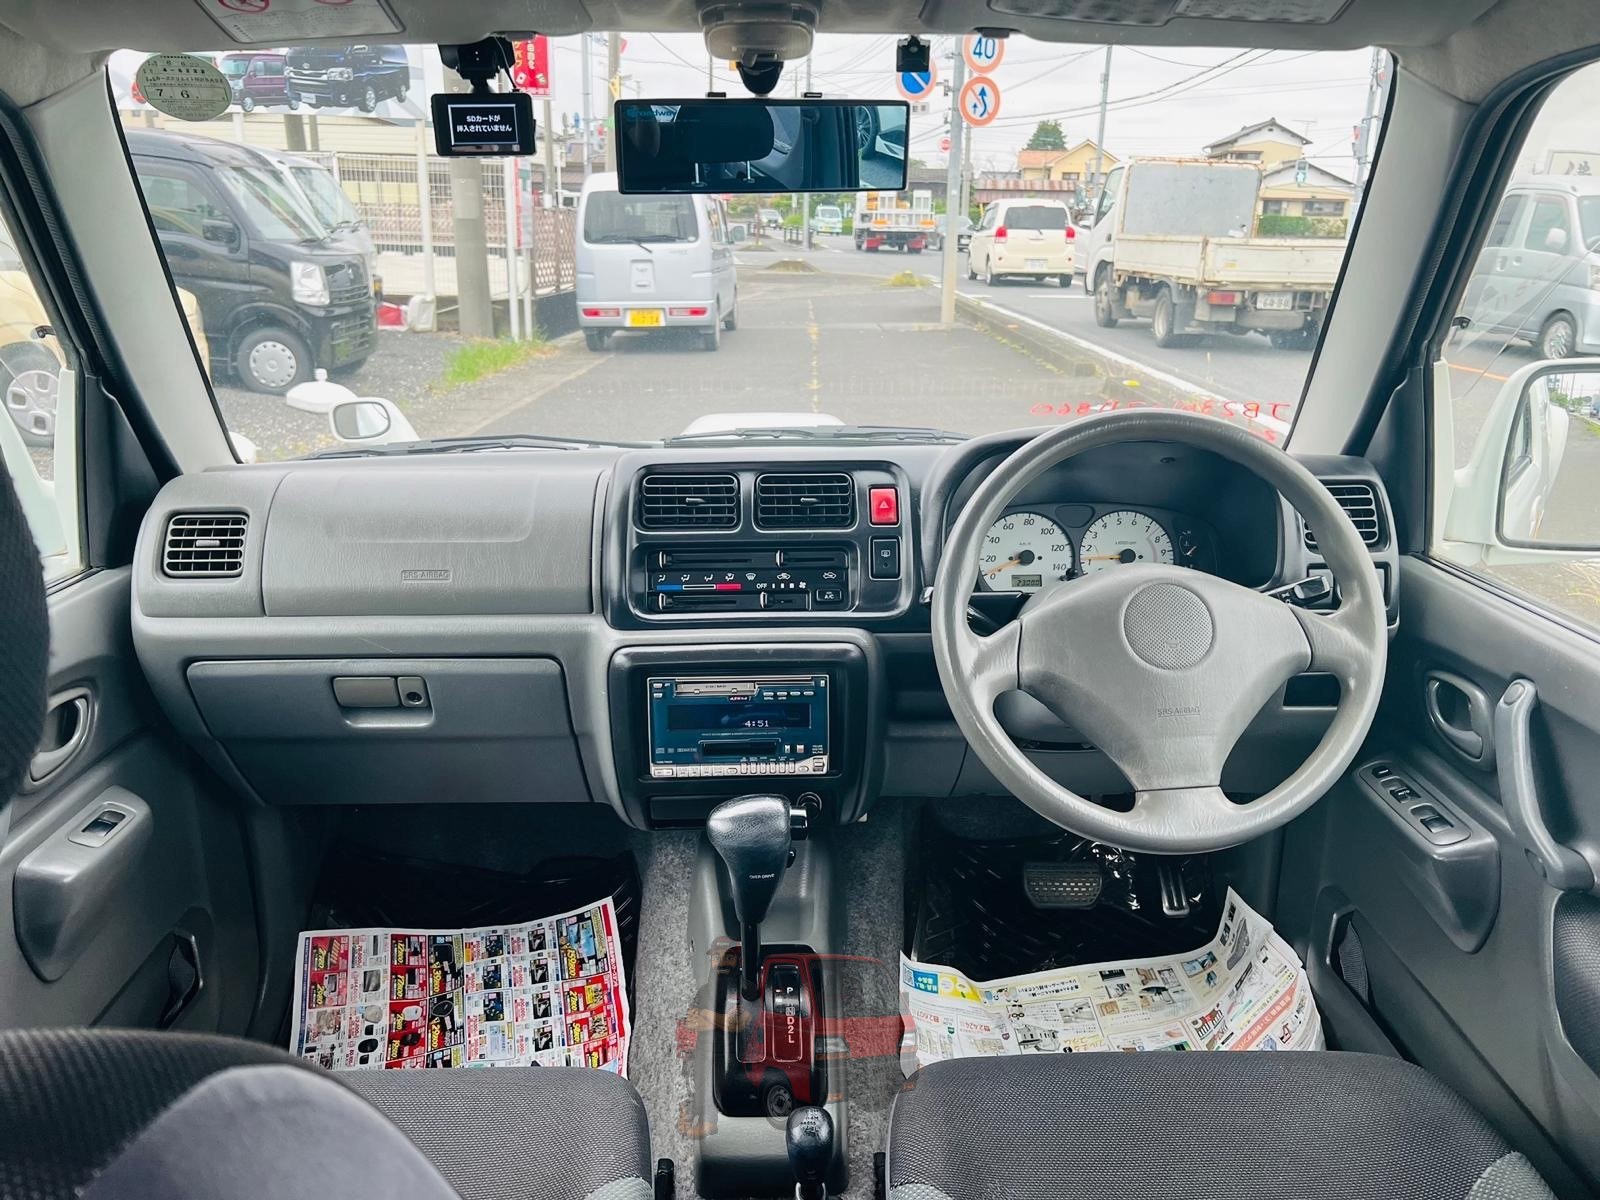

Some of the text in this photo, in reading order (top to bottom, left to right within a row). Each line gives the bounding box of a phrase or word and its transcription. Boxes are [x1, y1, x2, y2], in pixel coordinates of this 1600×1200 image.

[973, 37, 996, 59] 40
[466, 114, 501, 122] SDカードが
[456, 124, 512, 133] 挿入されていません
[989, 536, 1000, 544] 40
[744, 720, 768, 728] 4:51
[787, 1017, 795, 1025] D
[788, 1026, 794, 1034] 2
[788, 1035, 795, 1044] L
